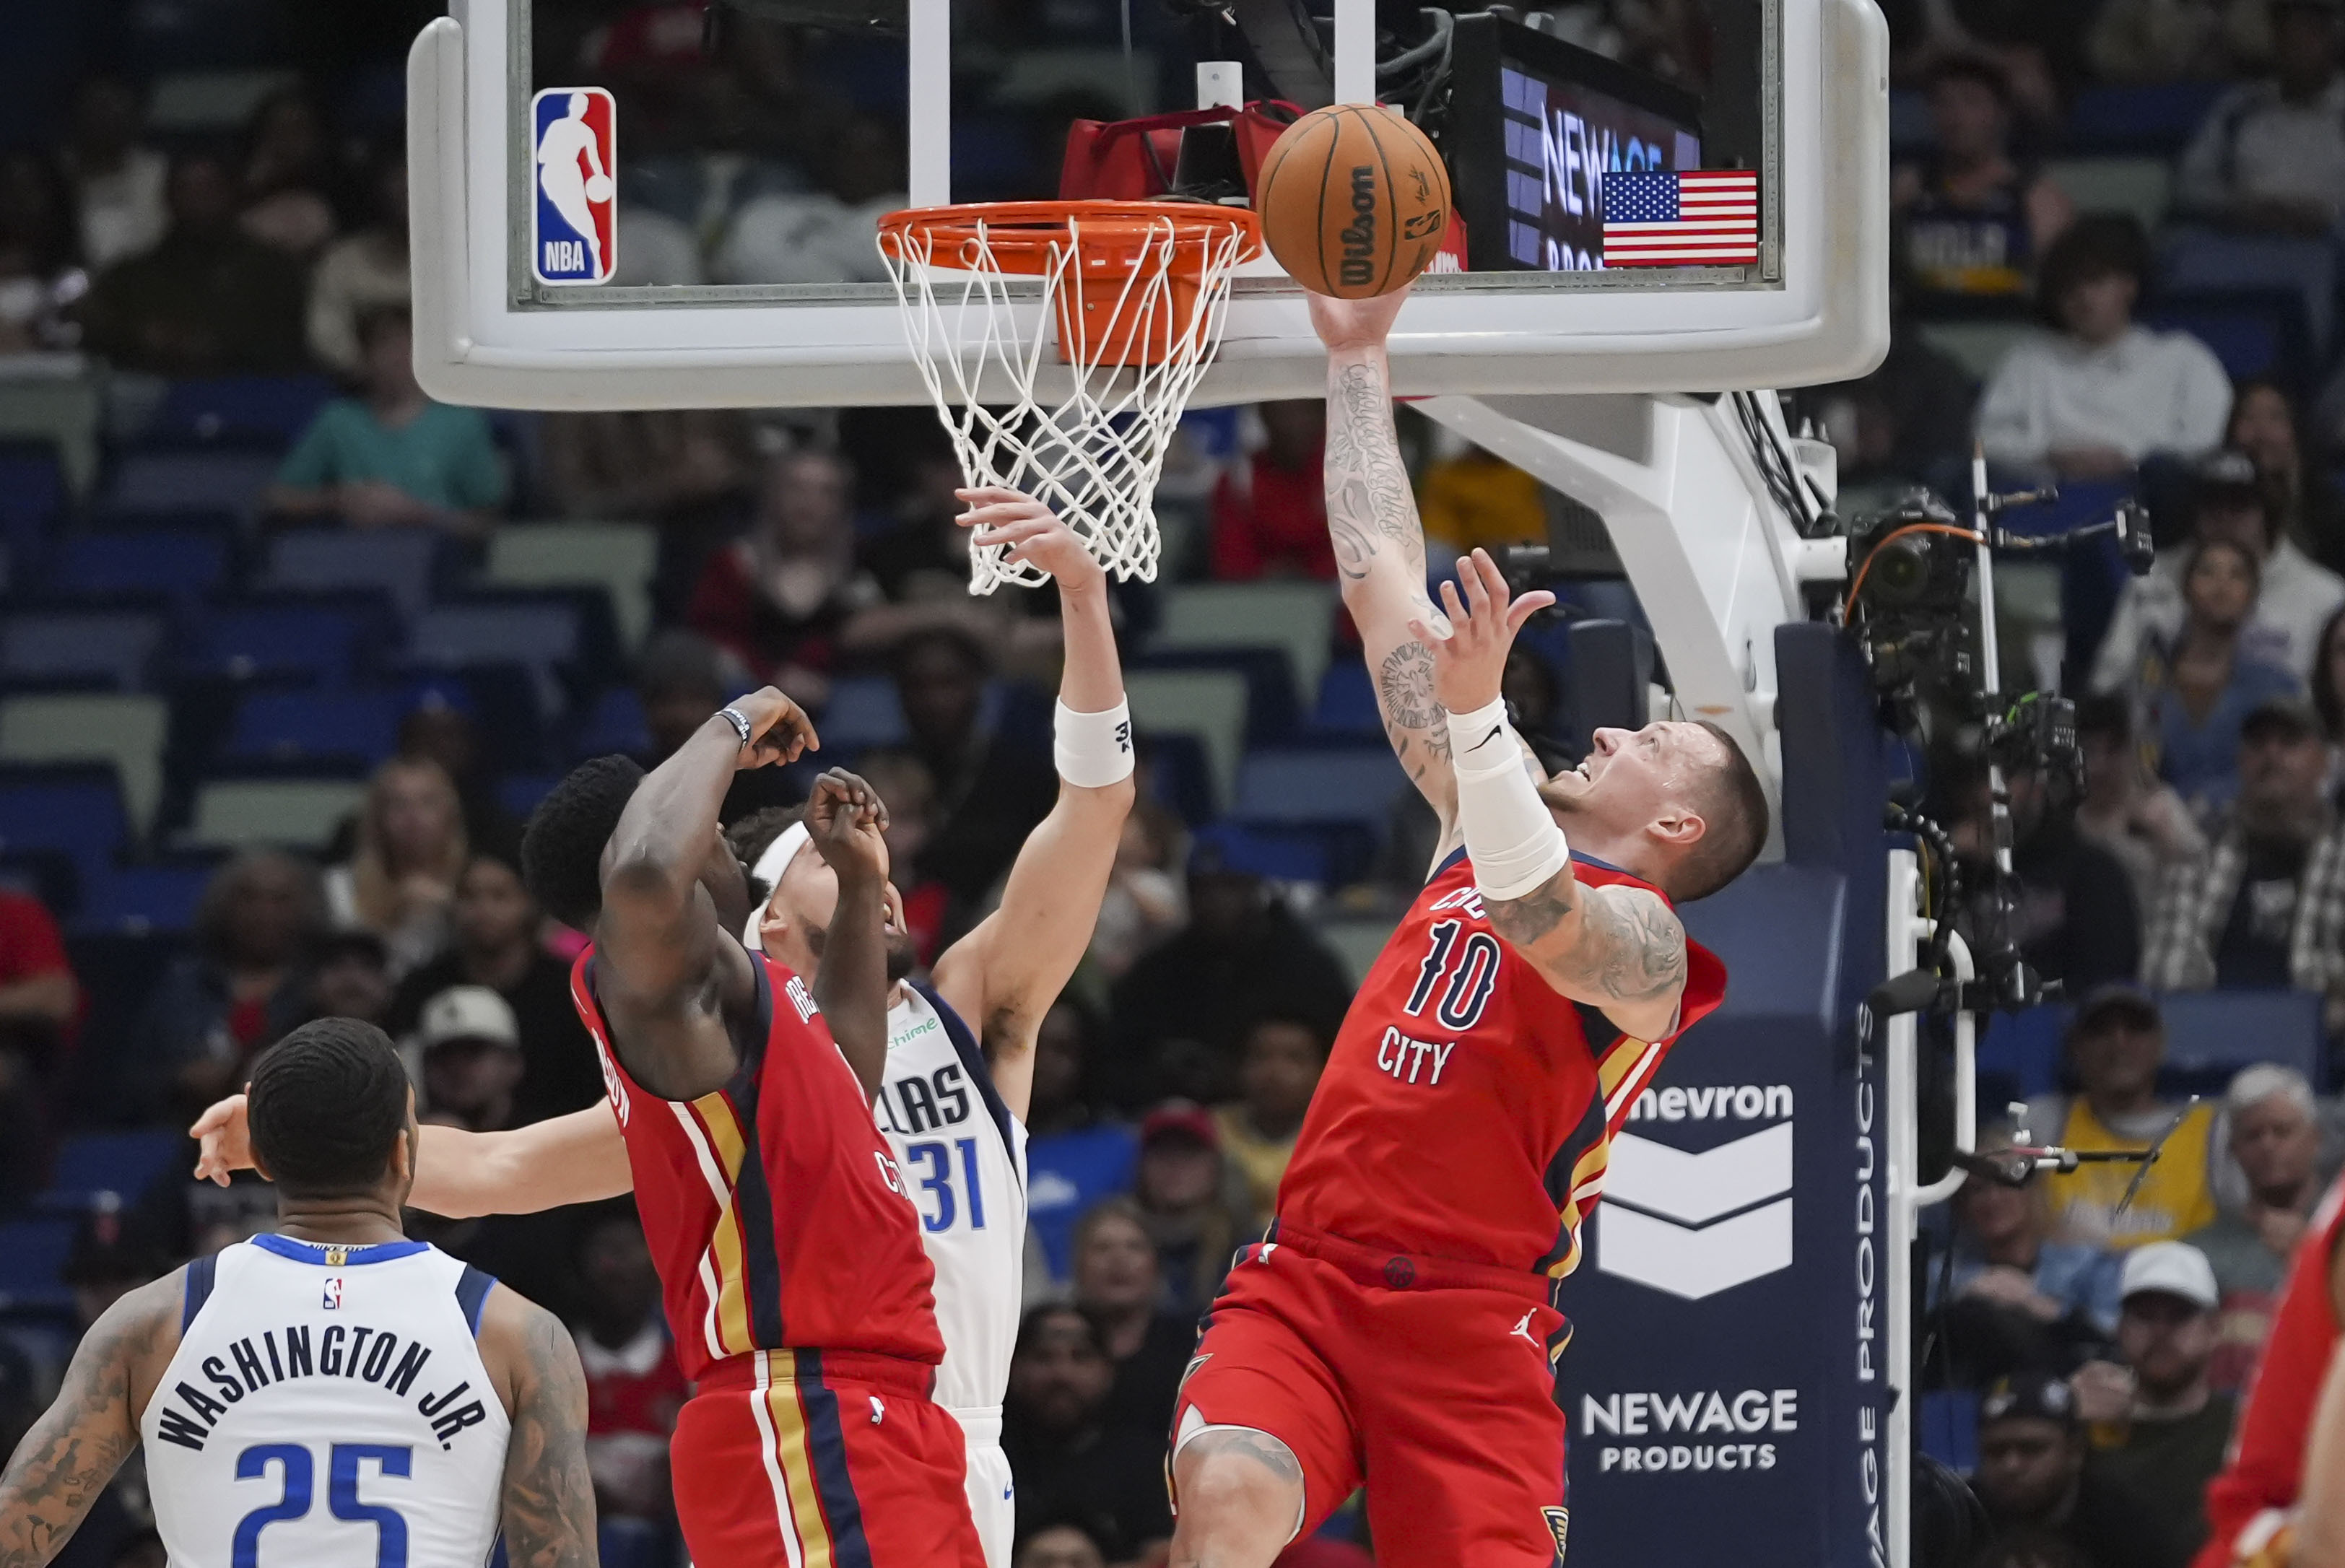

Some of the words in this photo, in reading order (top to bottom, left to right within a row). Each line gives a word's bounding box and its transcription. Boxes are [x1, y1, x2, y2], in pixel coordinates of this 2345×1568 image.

[545, 240, 585, 272] NBA
[1339, 166, 1375, 286] Wilson
[1403, 918, 1501, 1031] 10
[1377, 1025, 1456, 1085] CITY
[907, 1136, 986, 1234] 31
[1857, 1001, 1875, 1380] PRODUCTS
[157, 1325, 432, 1452] WASHINGTON
[418, 1380, 486, 1452] JR.
[1583, 1389, 1798, 1436] NEWAGE
[230, 1442, 414, 1568] 25
[1600, 1443, 1776, 1471] PRODUCTS
